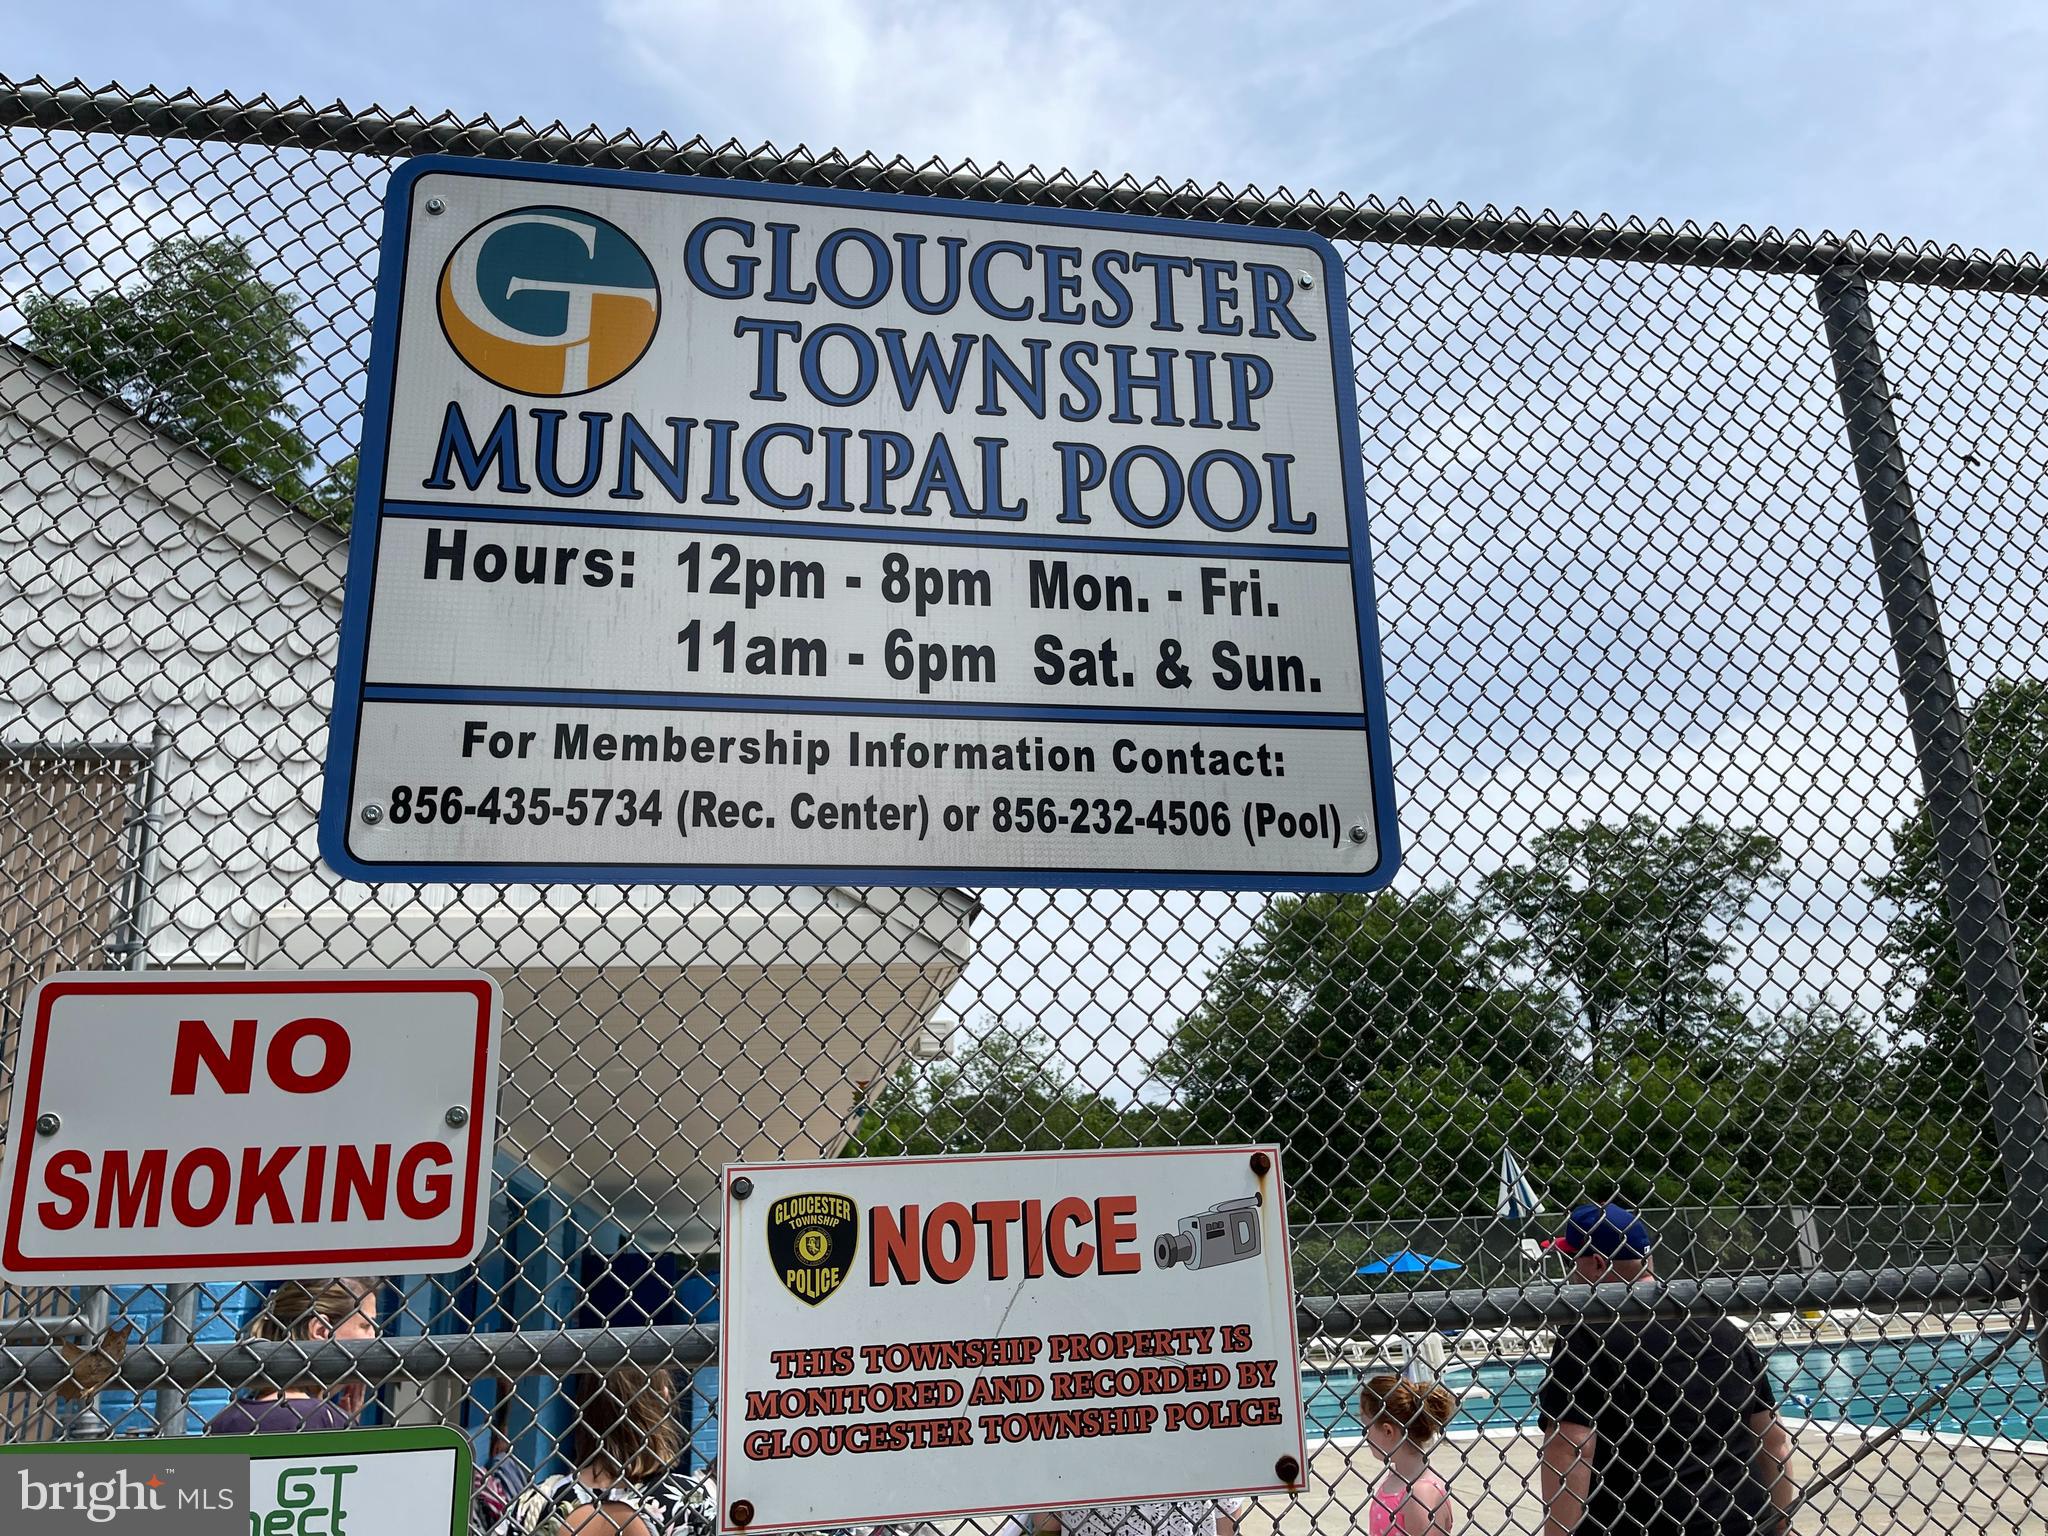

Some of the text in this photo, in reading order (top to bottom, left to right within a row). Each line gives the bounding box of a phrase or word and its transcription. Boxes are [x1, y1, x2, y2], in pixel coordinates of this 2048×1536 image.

[682, 216, 1317, 342] GLOUCESTER
[733, 315, 1274, 432] TOWNSHIP
[421, 400, 1318, 536] MUNICIPAL POOL
[423, 527, 1279, 618] Hours: 12pm - 8pm Mon. - Fri.
[677, 619, 1322, 695] 11am - 6pm Sat. & Sun.
[461, 720, 1285, 778] For Membership Information Contact:
[388, 784, 1341, 849] 856-435-5734 (Rec. Center) or 856-232-4506 (Pool)
[170, 1017, 351, 1096] NO
[37, 1141, 453, 1231] SMOKING
[775, 1196, 851, 1225] GLOUCESTER
[788, 1215, 840, 1230] TOWNSHIP
[868, 1195, 1142, 1288] NOTICE
[786, 1267, 840, 1299] POLICE
[769, 1323, 1253, 1380] THIS TOWNSHIP PROPERTY IS
[744, 1359, 1279, 1422] MONITORED AND RECORDED BY
[743, 1396, 1283, 1462] GLOUCESTER TOWNSHIP POLICE
[277, 1465, 358, 1510] GT
